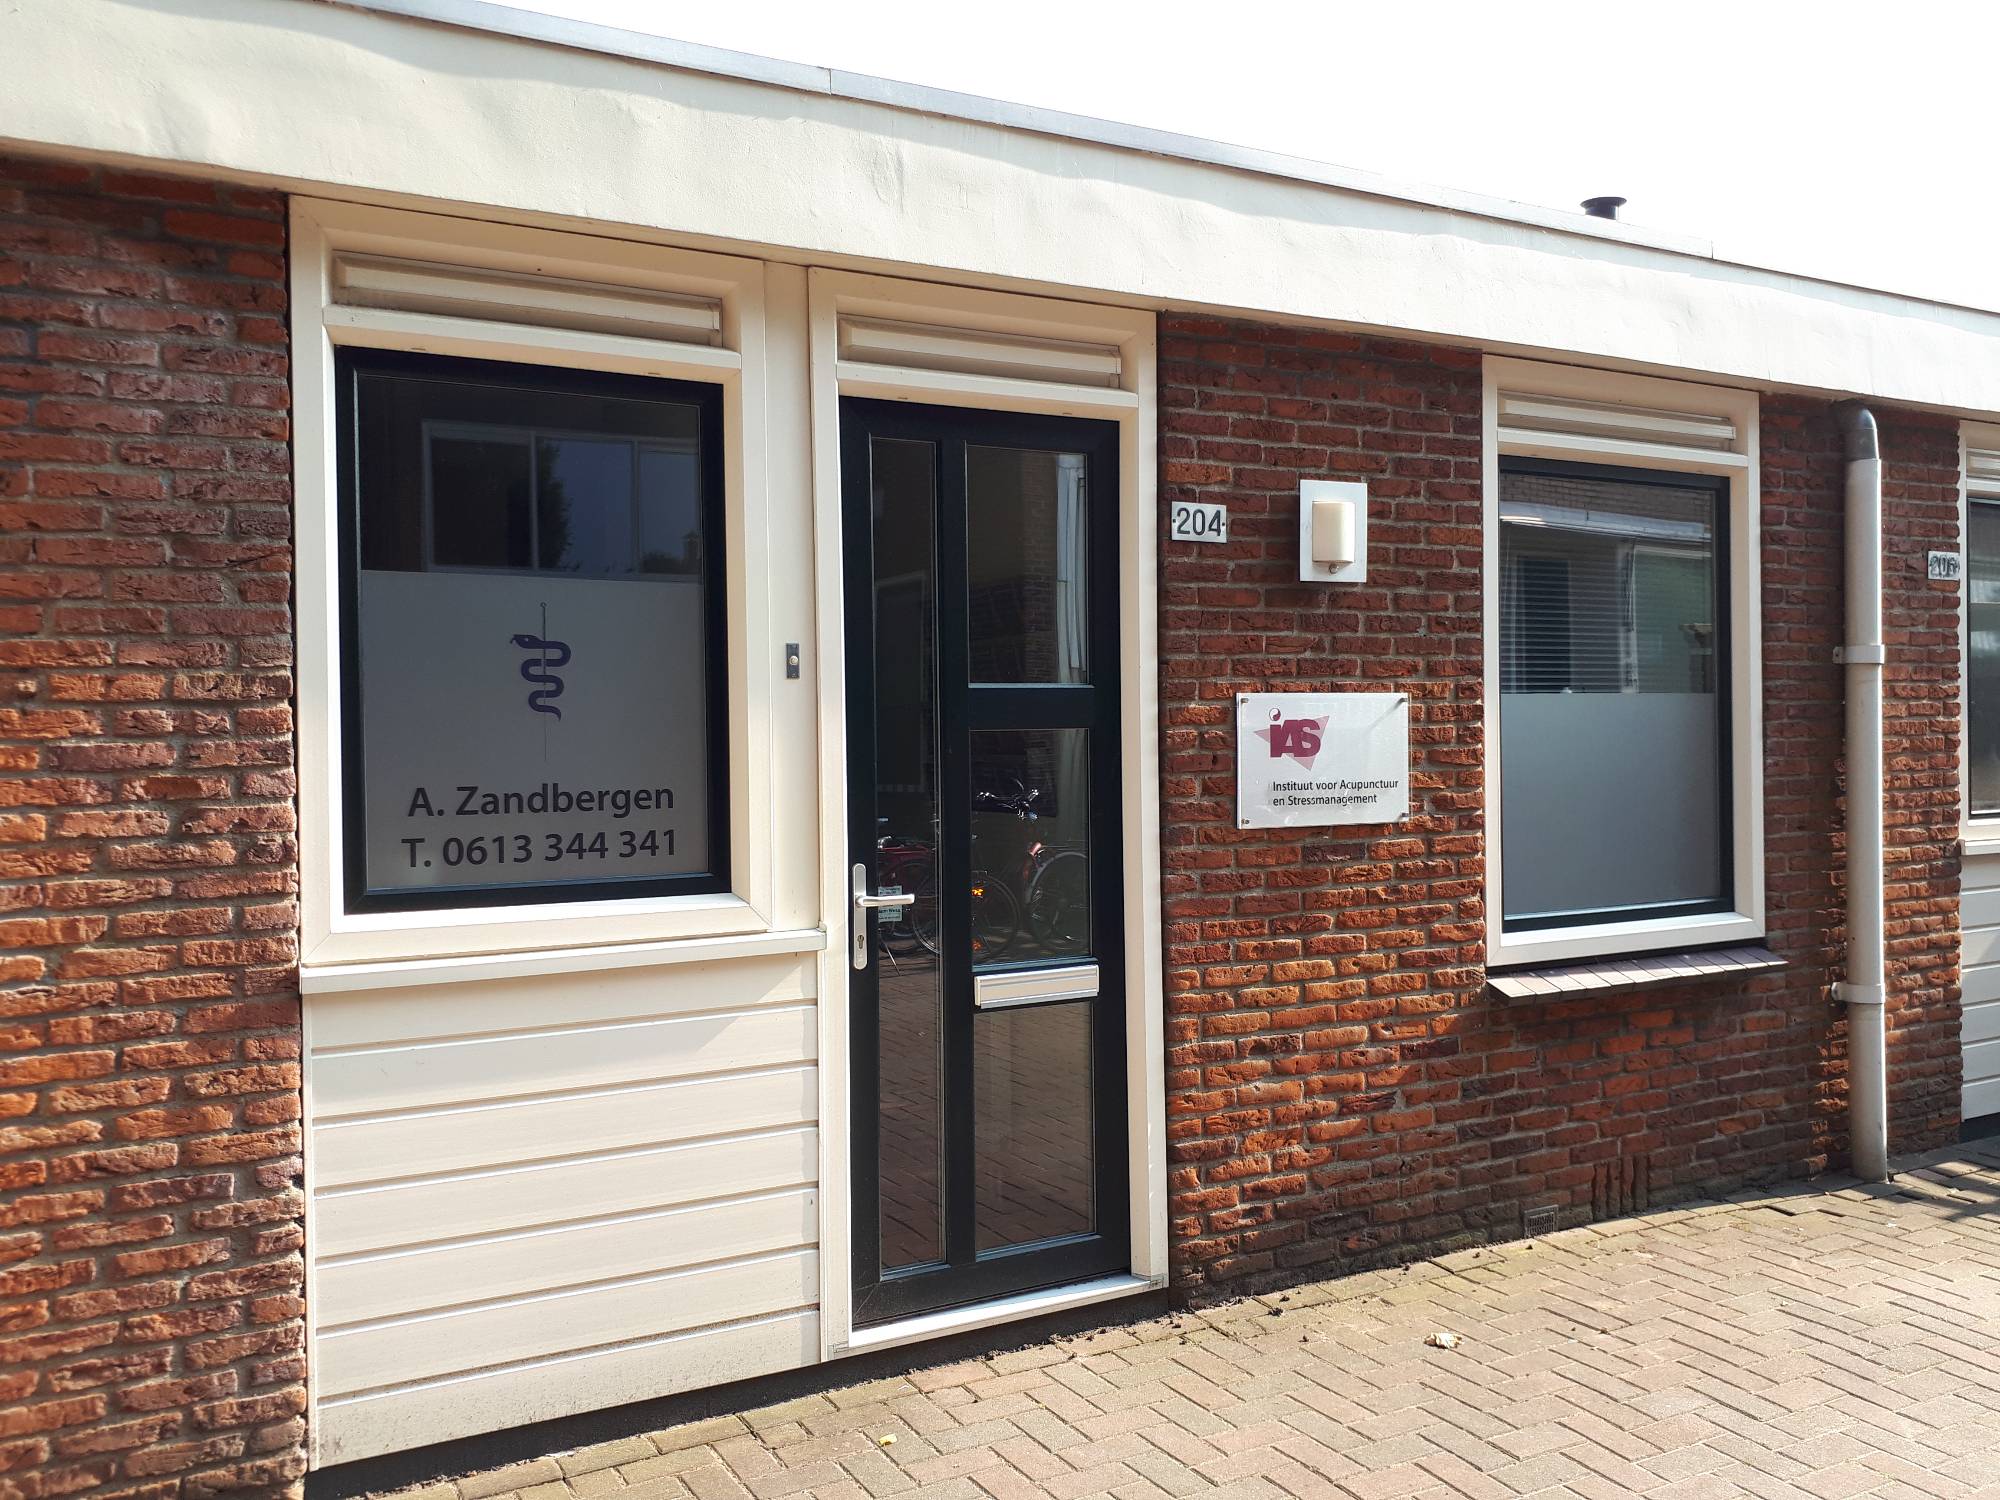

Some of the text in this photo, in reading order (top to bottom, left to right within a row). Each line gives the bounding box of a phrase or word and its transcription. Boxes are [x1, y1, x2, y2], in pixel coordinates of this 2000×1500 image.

[1176, 507, 1222, 537] 204
[408, 783, 675, 818] A. Zandbergen
[1272, 779, 1399, 792] Instituut voor Acupunctuur
[1272, 794, 1378, 807] en Stressmanagement
[401, 829, 675, 868] T. 0613 344 341
